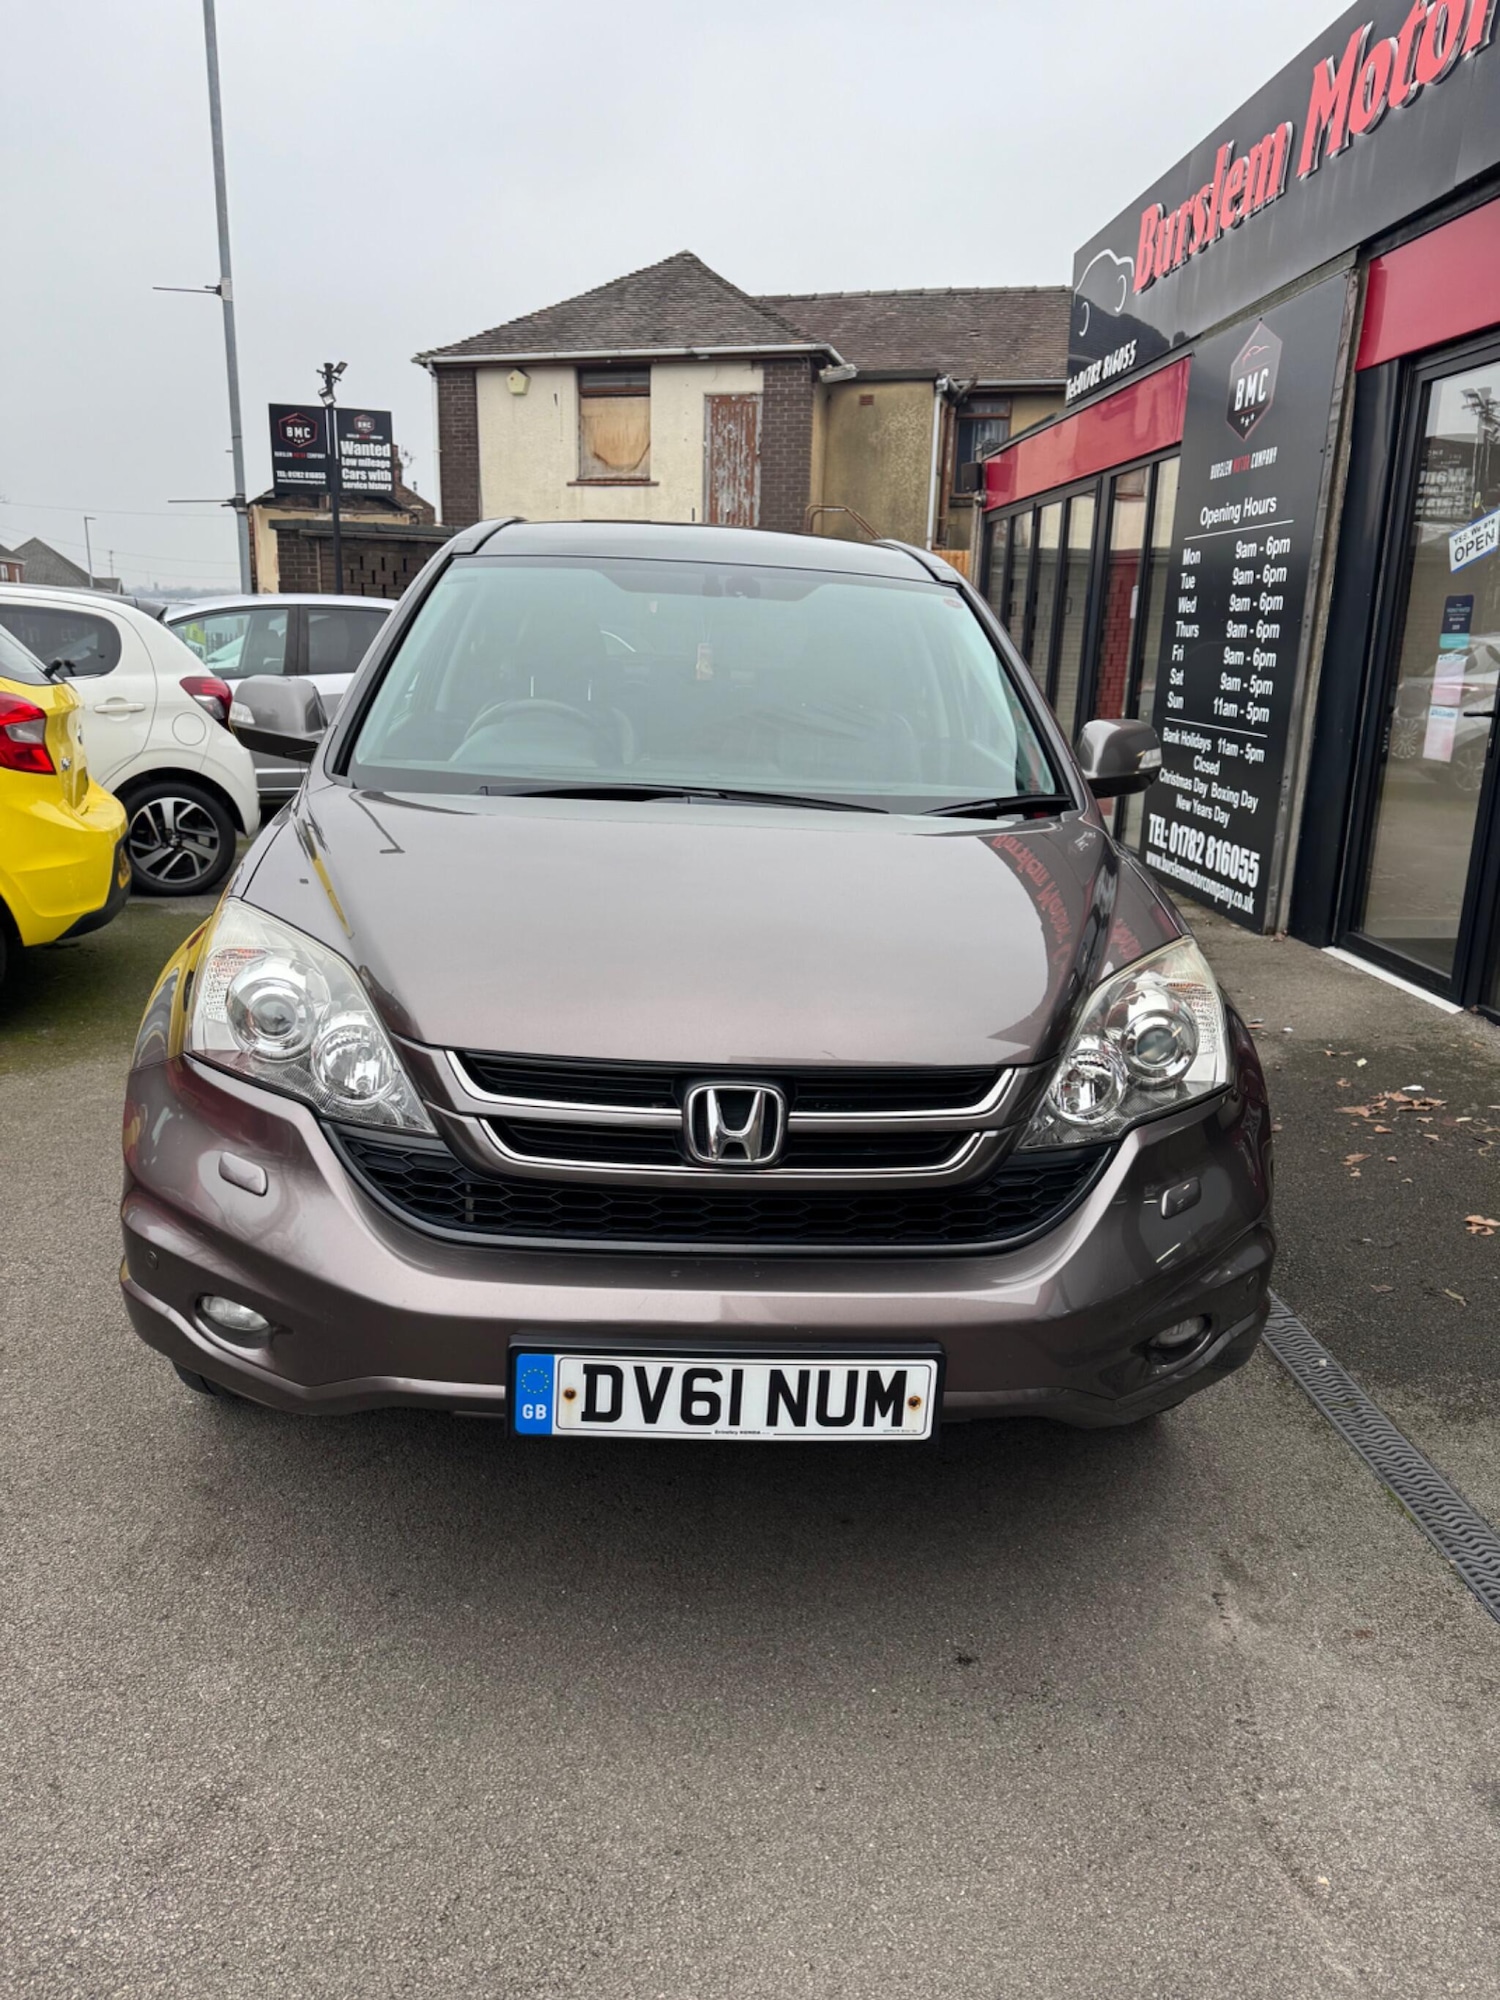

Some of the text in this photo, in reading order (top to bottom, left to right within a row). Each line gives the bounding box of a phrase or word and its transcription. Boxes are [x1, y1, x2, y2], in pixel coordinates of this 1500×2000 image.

[1132, 122, 1293, 294] Burslem
[1234, 368, 1269, 411] BMC
[286, 427, 311, 438] BMC
[340, 441, 391, 457] Wanted
[341, 456, 390, 469] Low mileage
[341, 468, 391, 481] Cars with
[1200, 497, 1277, 528] Opening Hours
[1182, 548, 1200, 565] Mon
[1235, 541, 1257, 559] 9am
[1266, 536, 1290, 559] 6pm
[1455, 528, 1495, 562] OPEN
[1181, 573, 1195, 589] Tue
[1232, 567, 1253, 585] 9am
[1262, 564, 1287, 587] 6pm
[1178, 596, 1197, 613] Wed
[1229, 594, 1250, 611] 9am
[1259, 592, 1283, 615] 6pm
[1176, 621, 1199, 638] Thurs
[1226, 620, 1247, 638] 9am
[1256, 620, 1280, 643] 6pm
[1172, 644, 1184, 661] Fri
[1223, 646, 1244, 665] 9am
[1253, 647, 1276, 671] 6pm
[1169, 668, 1184, 686] Sat
[1220, 672, 1241, 691] 9am
[1249, 675, 1273, 698] 5pm
[1167, 691, 1184, 709] Sun
[1213, 697, 1238, 718] 11am
[1246, 702, 1270, 725] 5pm
[1163, 727, 1180, 744] Bank
[1181, 730, 1212, 753] Holidays
[1217, 738, 1239, 757] 11am
[1244, 743, 1265, 764] 5pm
[1193, 755, 1220, 776] Closed
[1159, 768, 1258, 814] Christmas Day Boxing Day
[1176, 794, 1230, 828] New Years Day
[1169, 821, 1205, 865] 01782
[1205, 835, 1260, 888] 816055
[581, 1364, 908, 1428] DV61 NUM
[522, 1404, 547, 1420] GB
